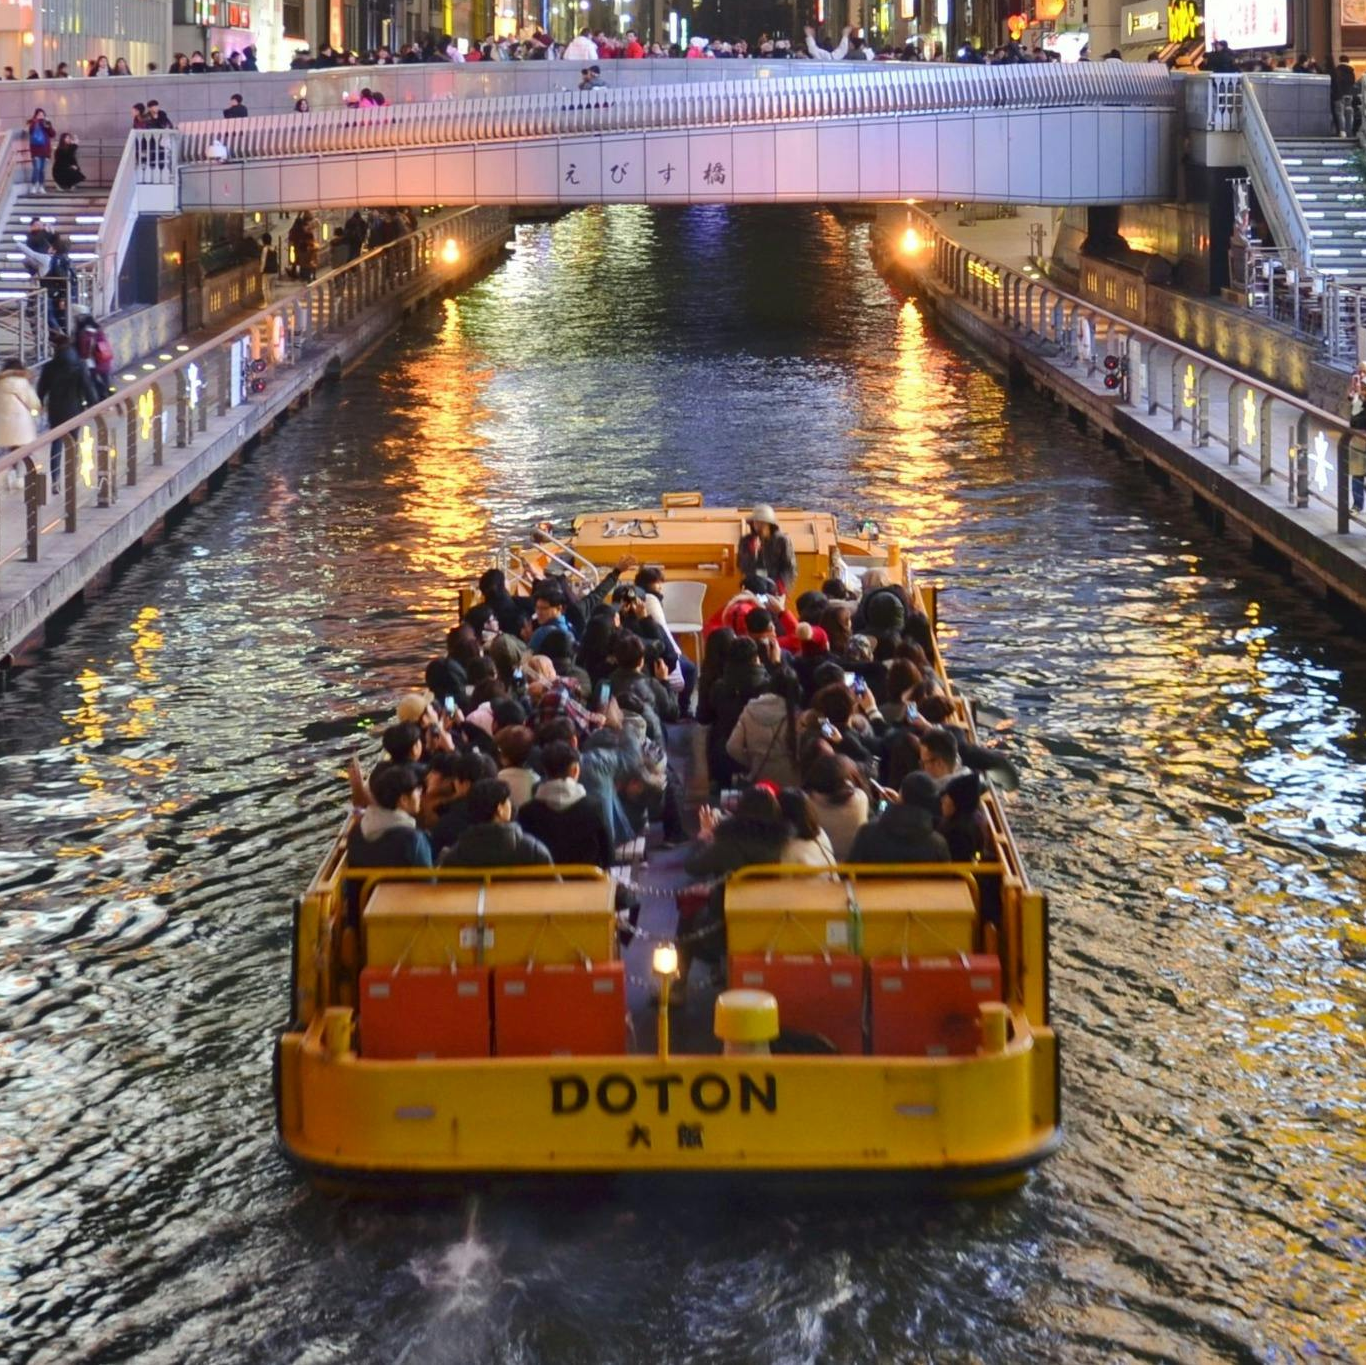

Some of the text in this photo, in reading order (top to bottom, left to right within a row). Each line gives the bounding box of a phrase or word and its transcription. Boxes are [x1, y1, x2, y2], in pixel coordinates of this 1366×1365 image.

[564, 160, 727, 188] えびす橋
[549, 1073, 778, 1115] DOTON
